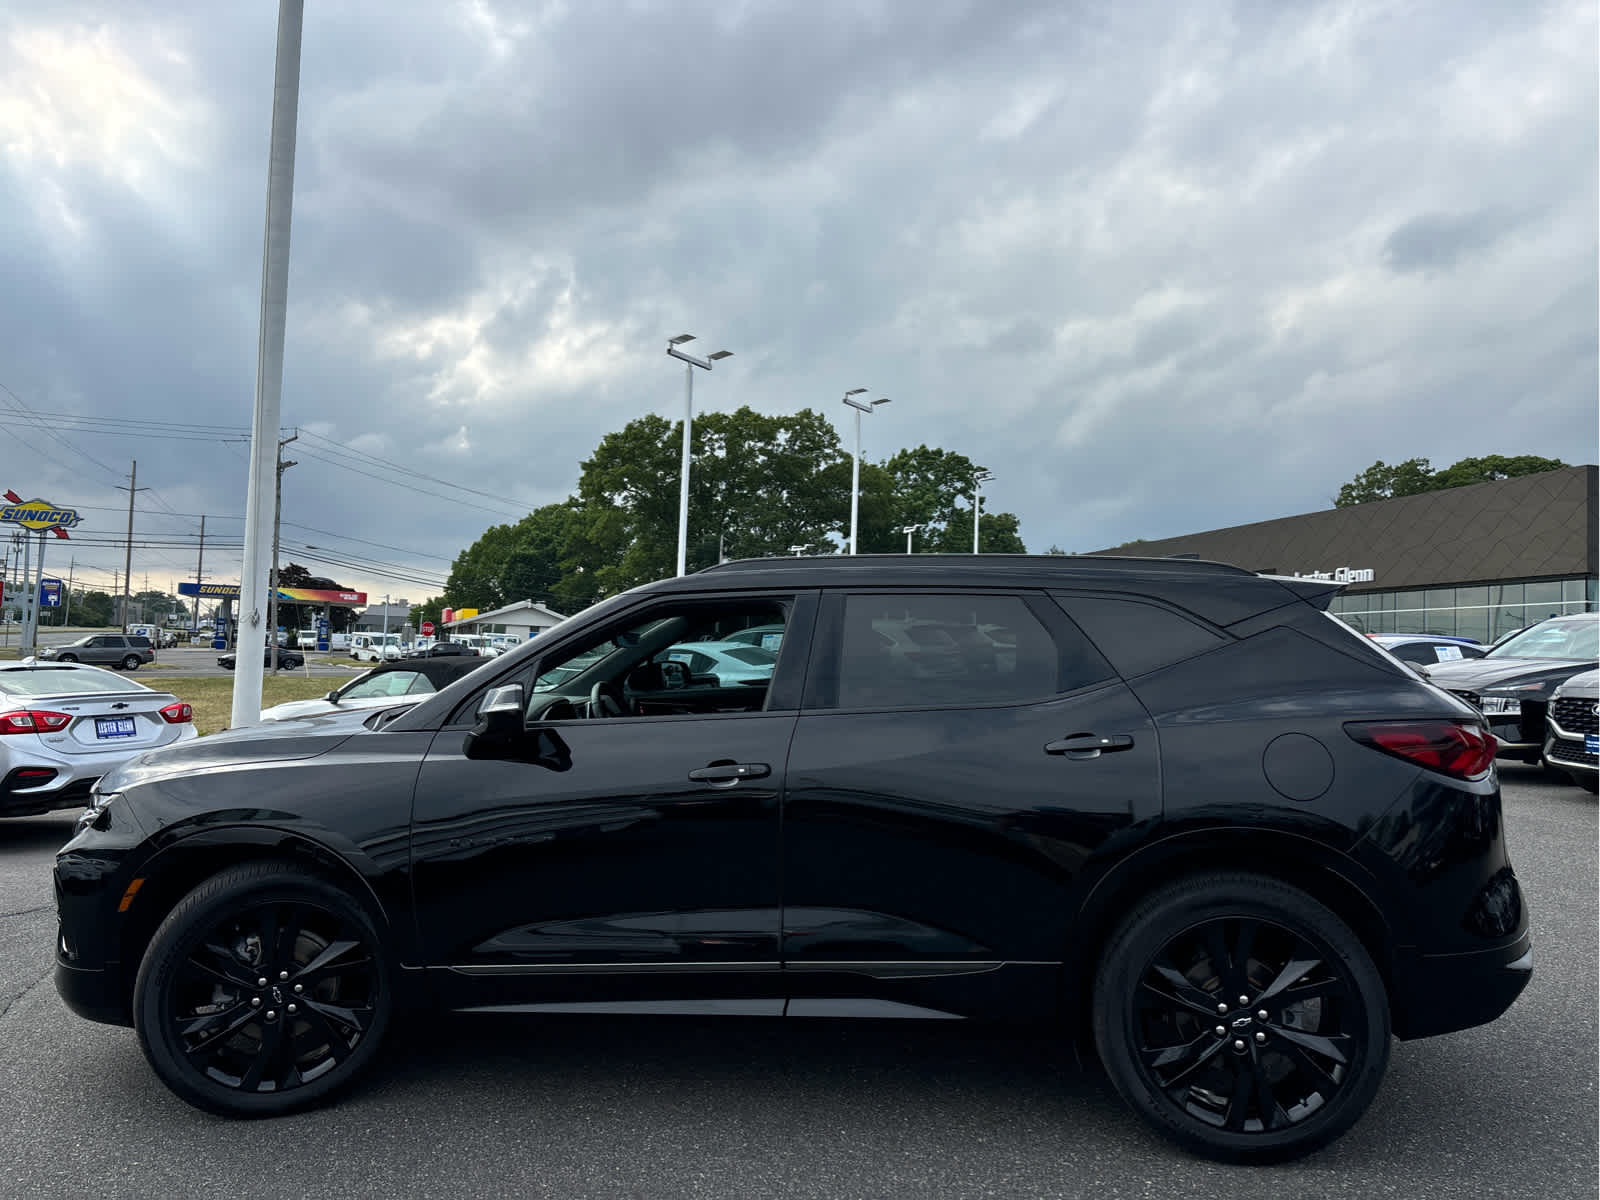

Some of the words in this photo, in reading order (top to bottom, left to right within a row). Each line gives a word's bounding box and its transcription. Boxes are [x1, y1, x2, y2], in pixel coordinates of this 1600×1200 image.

[1, 508, 72, 523] SUNOCO
[1335, 567, 1375, 583] Glenn
[97, 721, 117, 734] LESTER
[117, 719, 134, 732] GLENN
